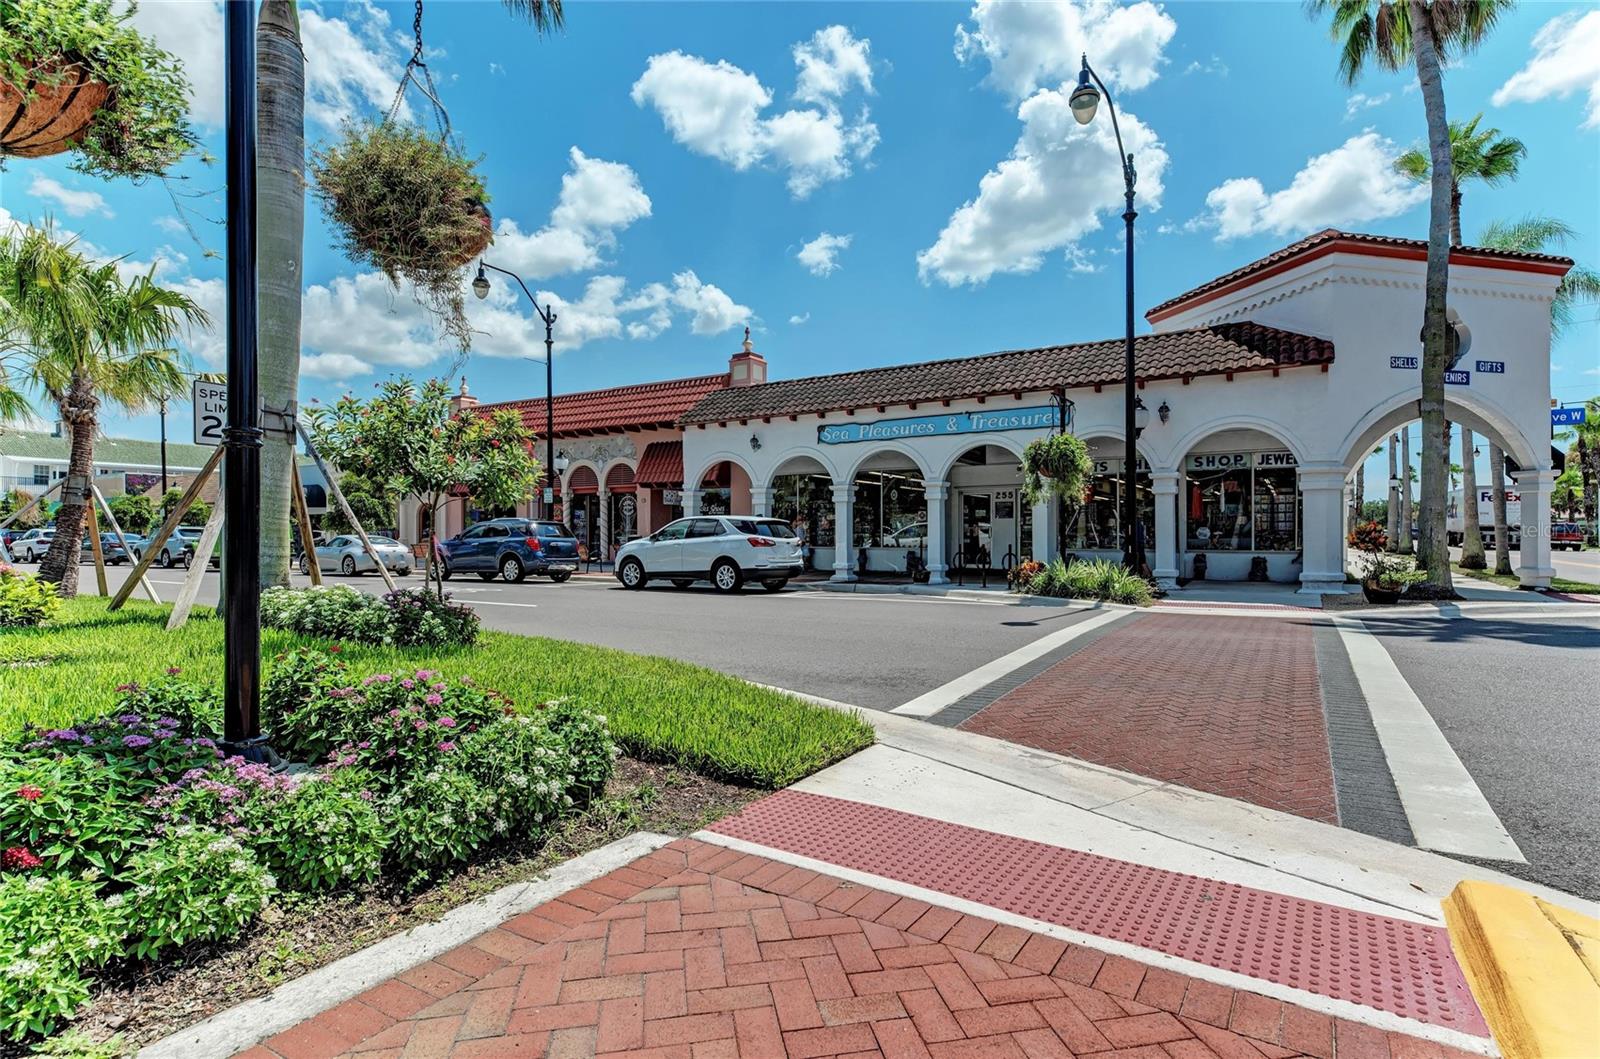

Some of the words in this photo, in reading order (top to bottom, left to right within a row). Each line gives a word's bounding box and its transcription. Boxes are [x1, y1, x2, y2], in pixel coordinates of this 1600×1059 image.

[1391, 358, 1418, 368] SHELLS
[1480, 362, 1502, 372] GIFTS
[1444, 372, 1467, 383] ENIRS
[199, 388, 228, 401] SPE
[204, 402, 228, 413] LIM
[1571, 411, 1581, 420] W
[202, 415, 222, 438] 2
[822, 428, 849, 441] Sea
[860, 422, 936, 439] Pleasures
[946, 416, 958, 431] &
[1194, 454, 1244, 467] SHOP
[1258, 453, 1297, 465] JEWE
[995, 491, 1013, 499] 255
[1481, 491, 1521, 502] FeEx
